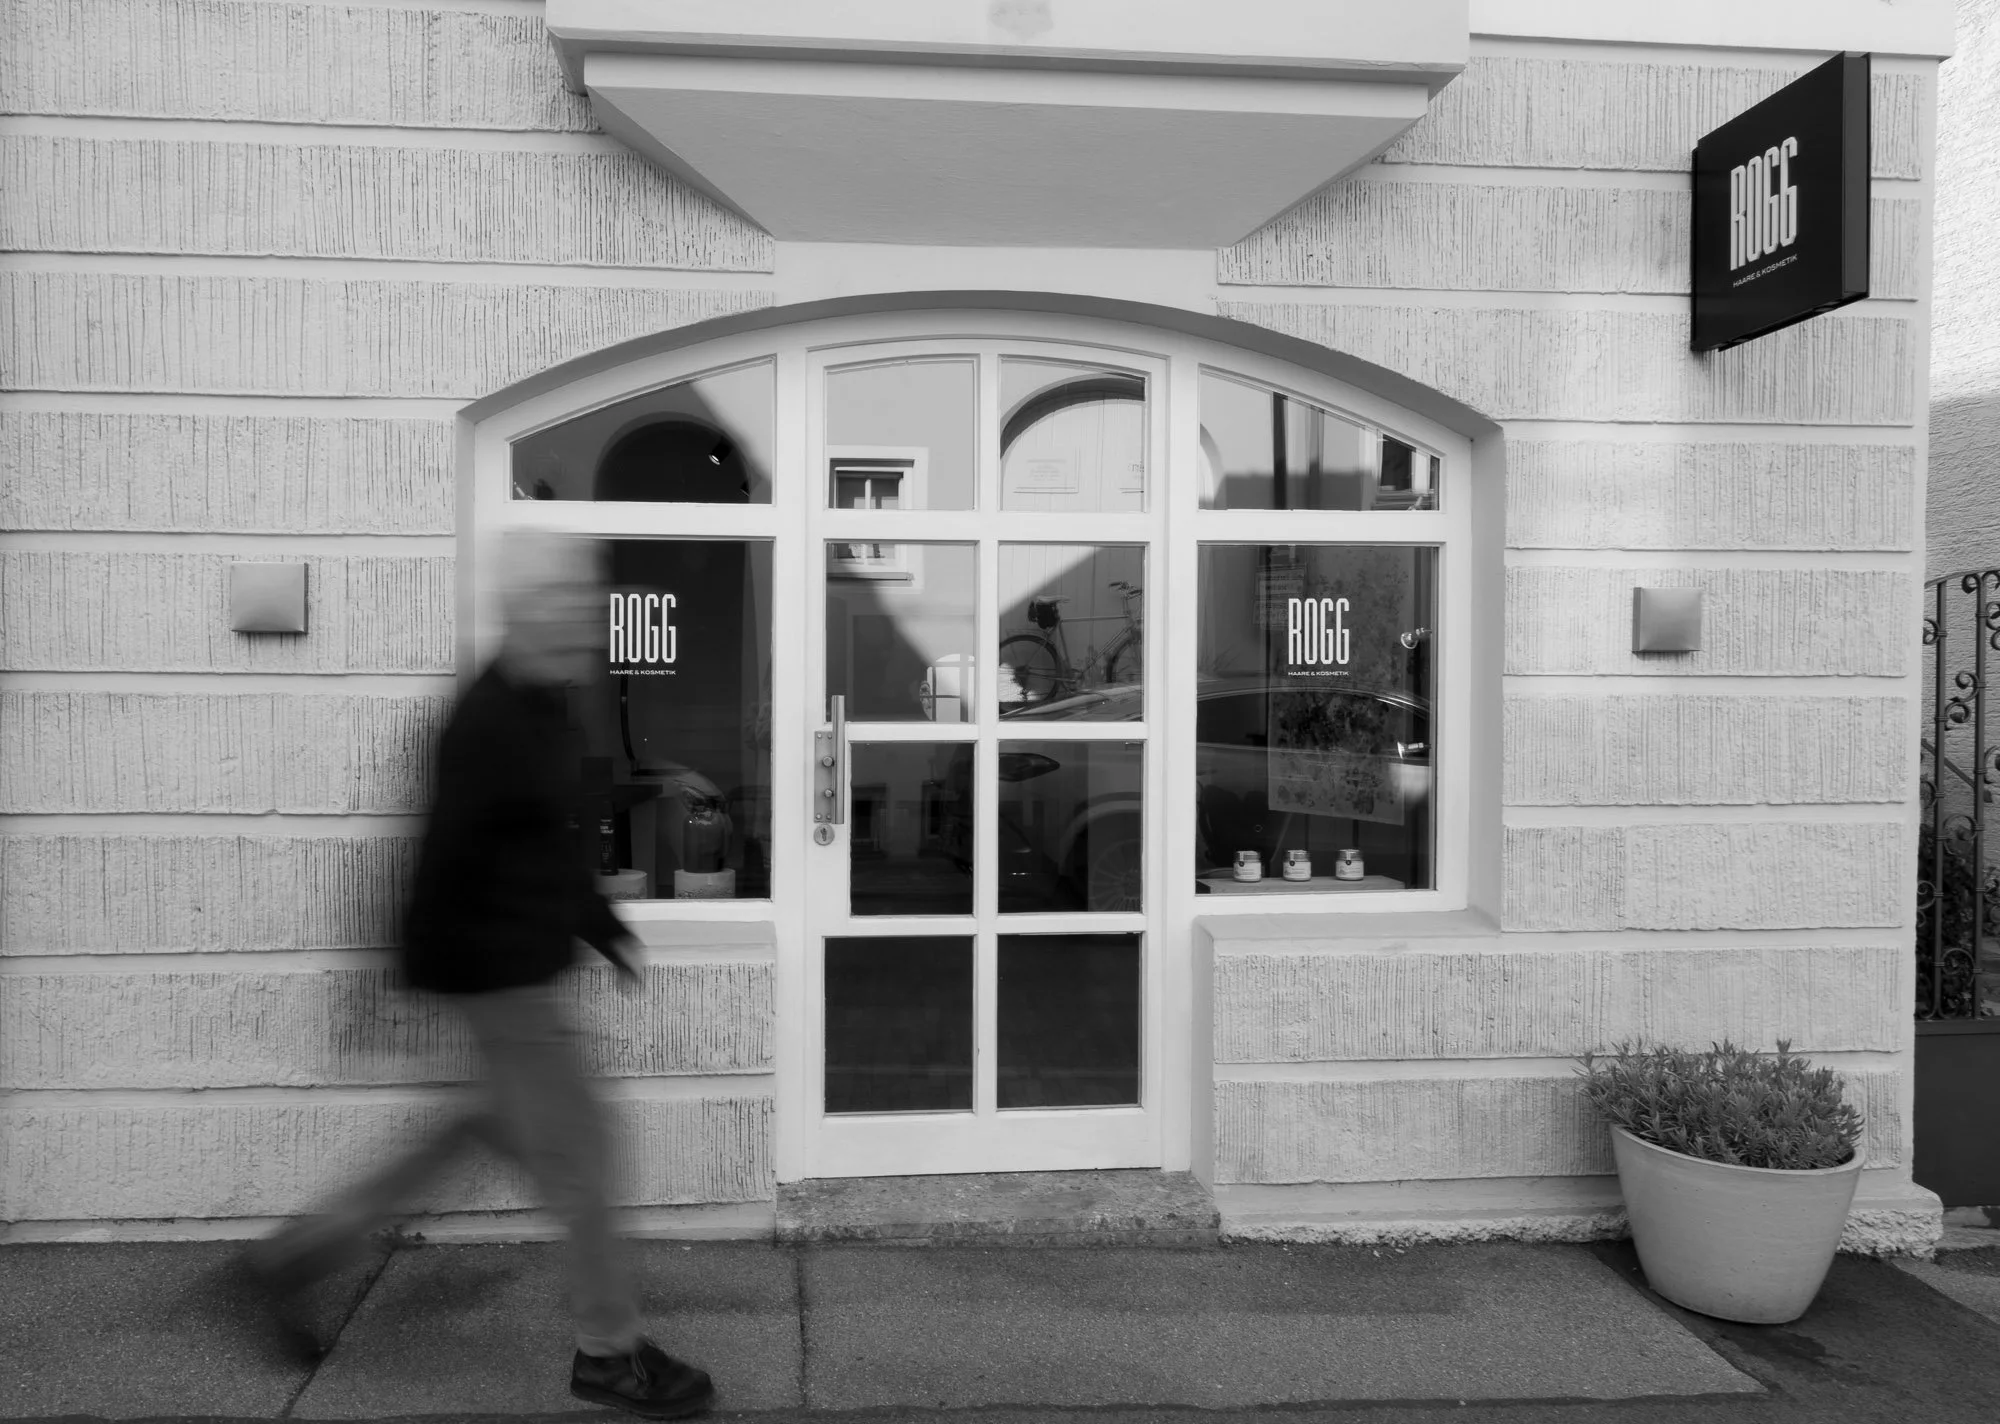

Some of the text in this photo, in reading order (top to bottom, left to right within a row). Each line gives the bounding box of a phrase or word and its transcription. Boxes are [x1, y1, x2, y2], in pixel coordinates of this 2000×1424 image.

[1730, 136, 1798, 271] ROGG
[1732, 253, 1798, 288] HAARE & KOSMETIK
[610, 593, 677, 663] ROGG
[1288, 598, 1350, 665] ROGG
